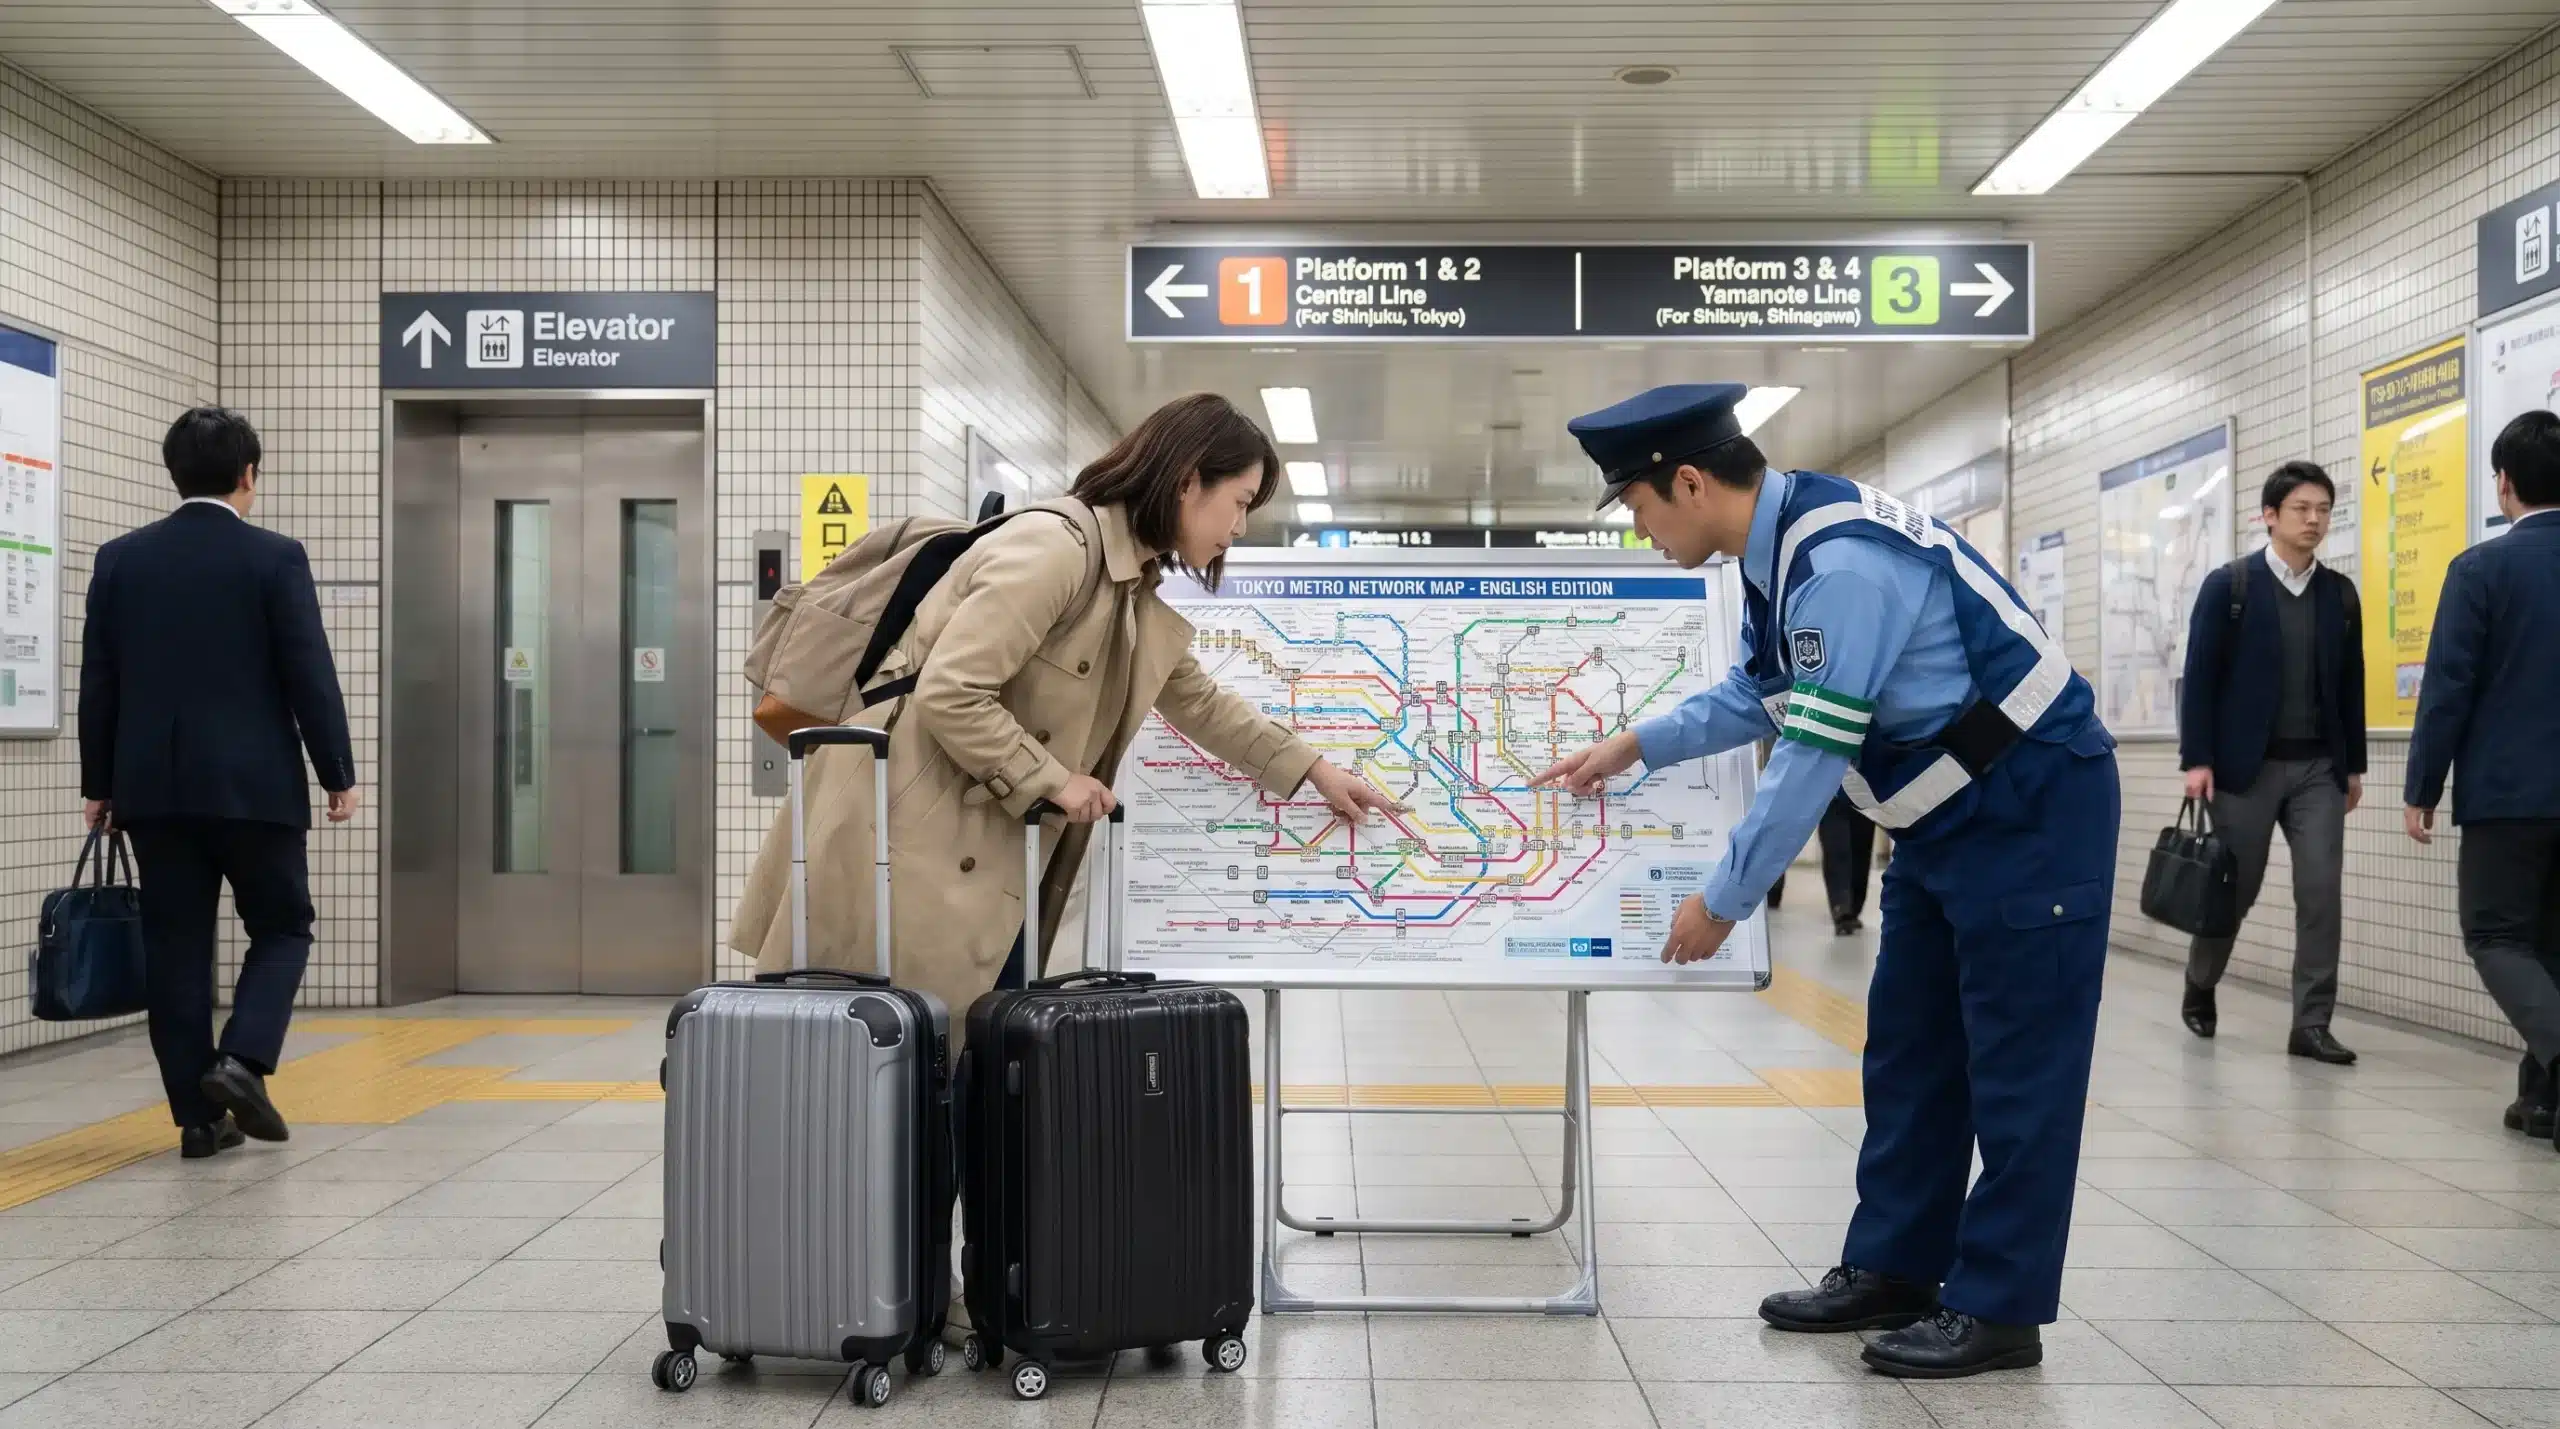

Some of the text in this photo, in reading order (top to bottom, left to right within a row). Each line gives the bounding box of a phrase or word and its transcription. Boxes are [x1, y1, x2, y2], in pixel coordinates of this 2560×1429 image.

[1295, 257, 1481, 281] Platform 1 & 2
[1673, 256, 1861, 281] Platform 3 & 4
[1237, 266, 1262, 316] 1
[1295, 284, 1428, 305] Central Line
[1700, 284, 1862, 305] Yamanote Line
[1888, 266, 1923, 314] 3
[533, 311, 675, 341] Elevator
[1295, 308, 1466, 328] (For Shinjuku, Tokyo)
[1656, 307, 1862, 328] (For Shibuya, Shinagawa)
[533, 348, 620, 367] Elevator
[1233, 580, 1284, 595] TOKYO
[1290, 580, 1344, 595] METRO
[1349, 580, 1426, 595] NETWORK
[1430, 580, 1465, 595] MAP
[1480, 580, 1547, 595] ENGLISH
[1552, 580, 1613, 595] EDITION
